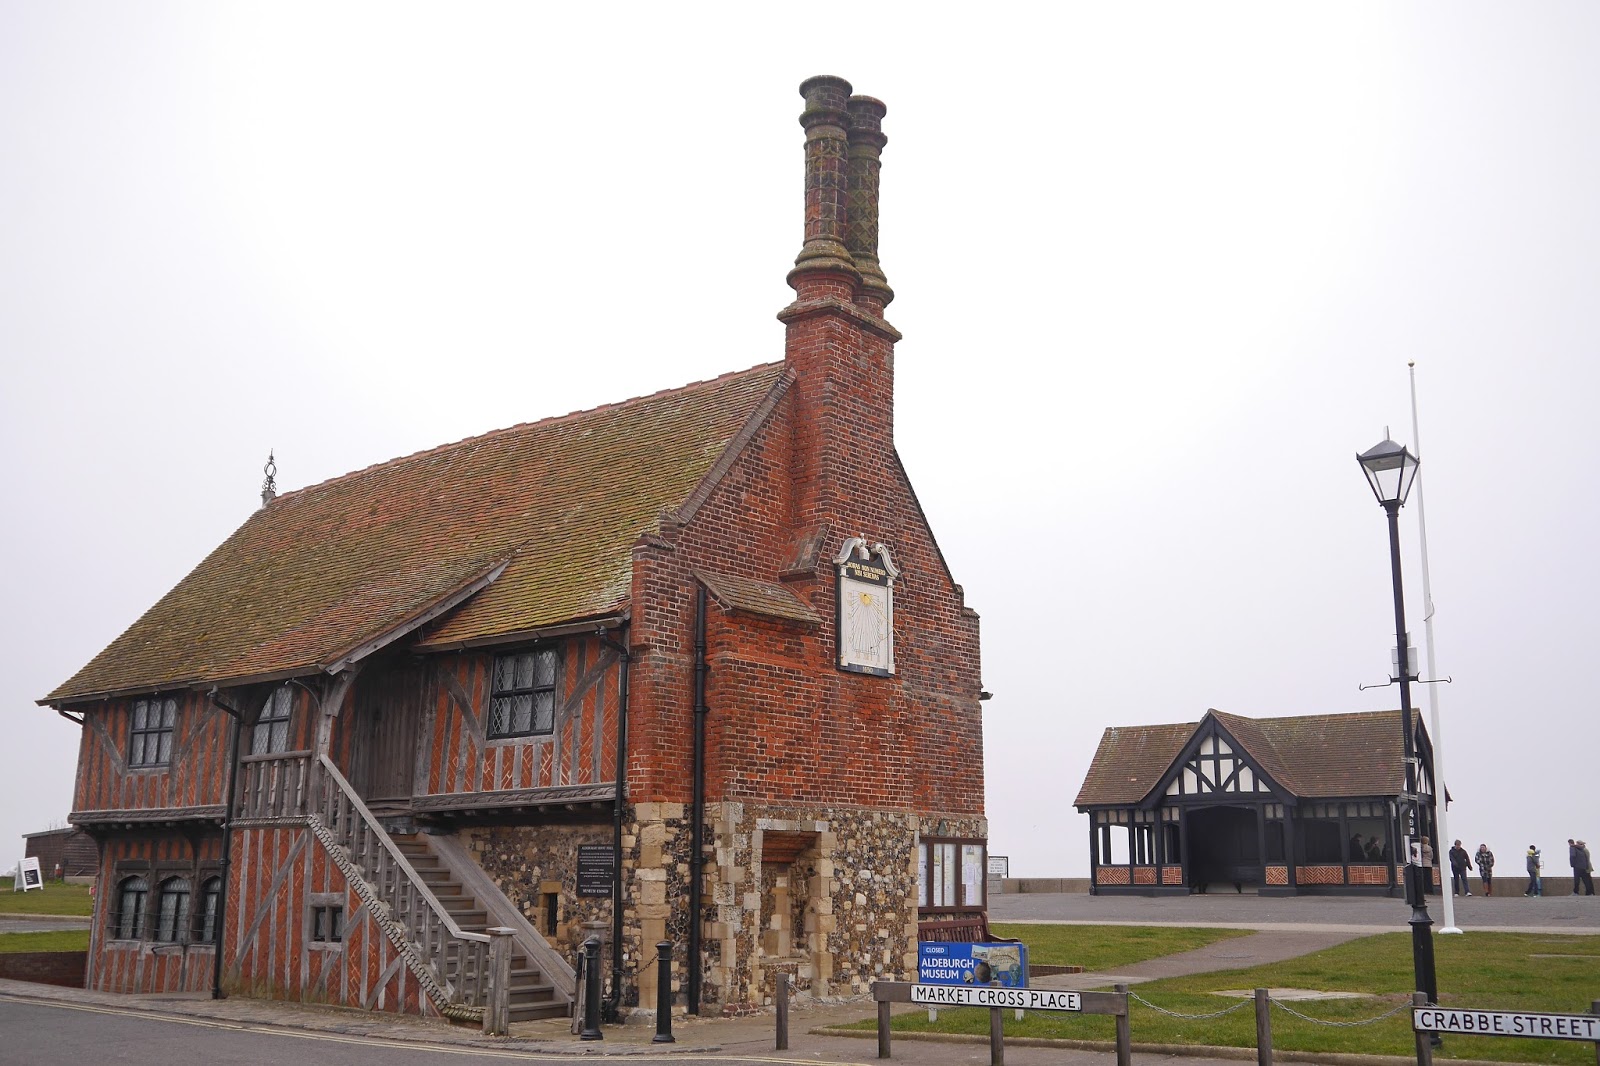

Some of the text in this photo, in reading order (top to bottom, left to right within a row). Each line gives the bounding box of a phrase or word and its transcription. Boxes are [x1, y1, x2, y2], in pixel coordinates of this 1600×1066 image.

[921, 958, 974, 969] ALDEBURGH
[921, 969, 959, 979] MUSEUM
[916, 987, 1076, 1009] MARKET CROSS PLACE
[1421, 1012, 1596, 1037] CRABBE STREET
